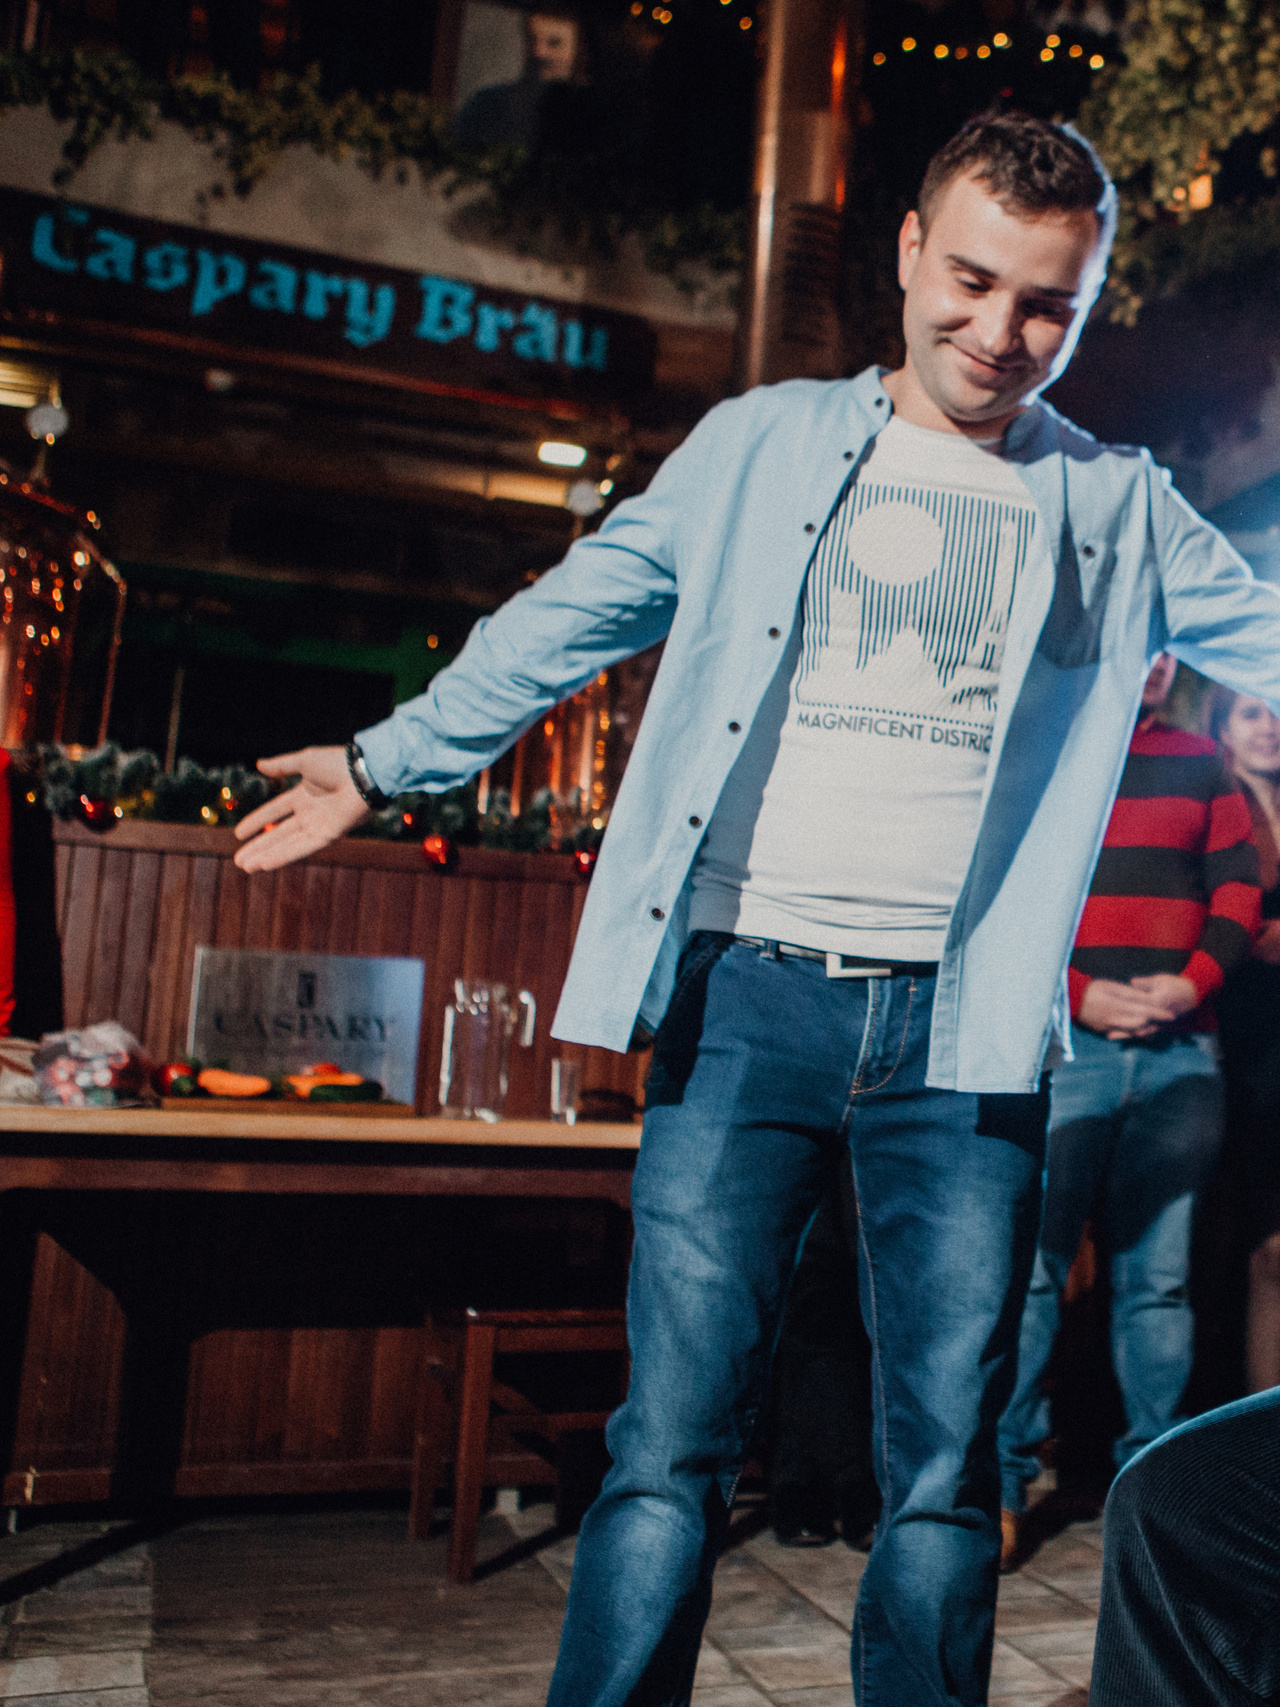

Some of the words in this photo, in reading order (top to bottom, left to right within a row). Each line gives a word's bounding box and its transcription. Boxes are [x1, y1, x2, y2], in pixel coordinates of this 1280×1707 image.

[31, 207, 395, 347] Caspary
[415, 275, 607, 370] Bräu
[797, 712, 924, 740] MAGNIFICENT
[213, 1010, 393, 1041] CASPARY
